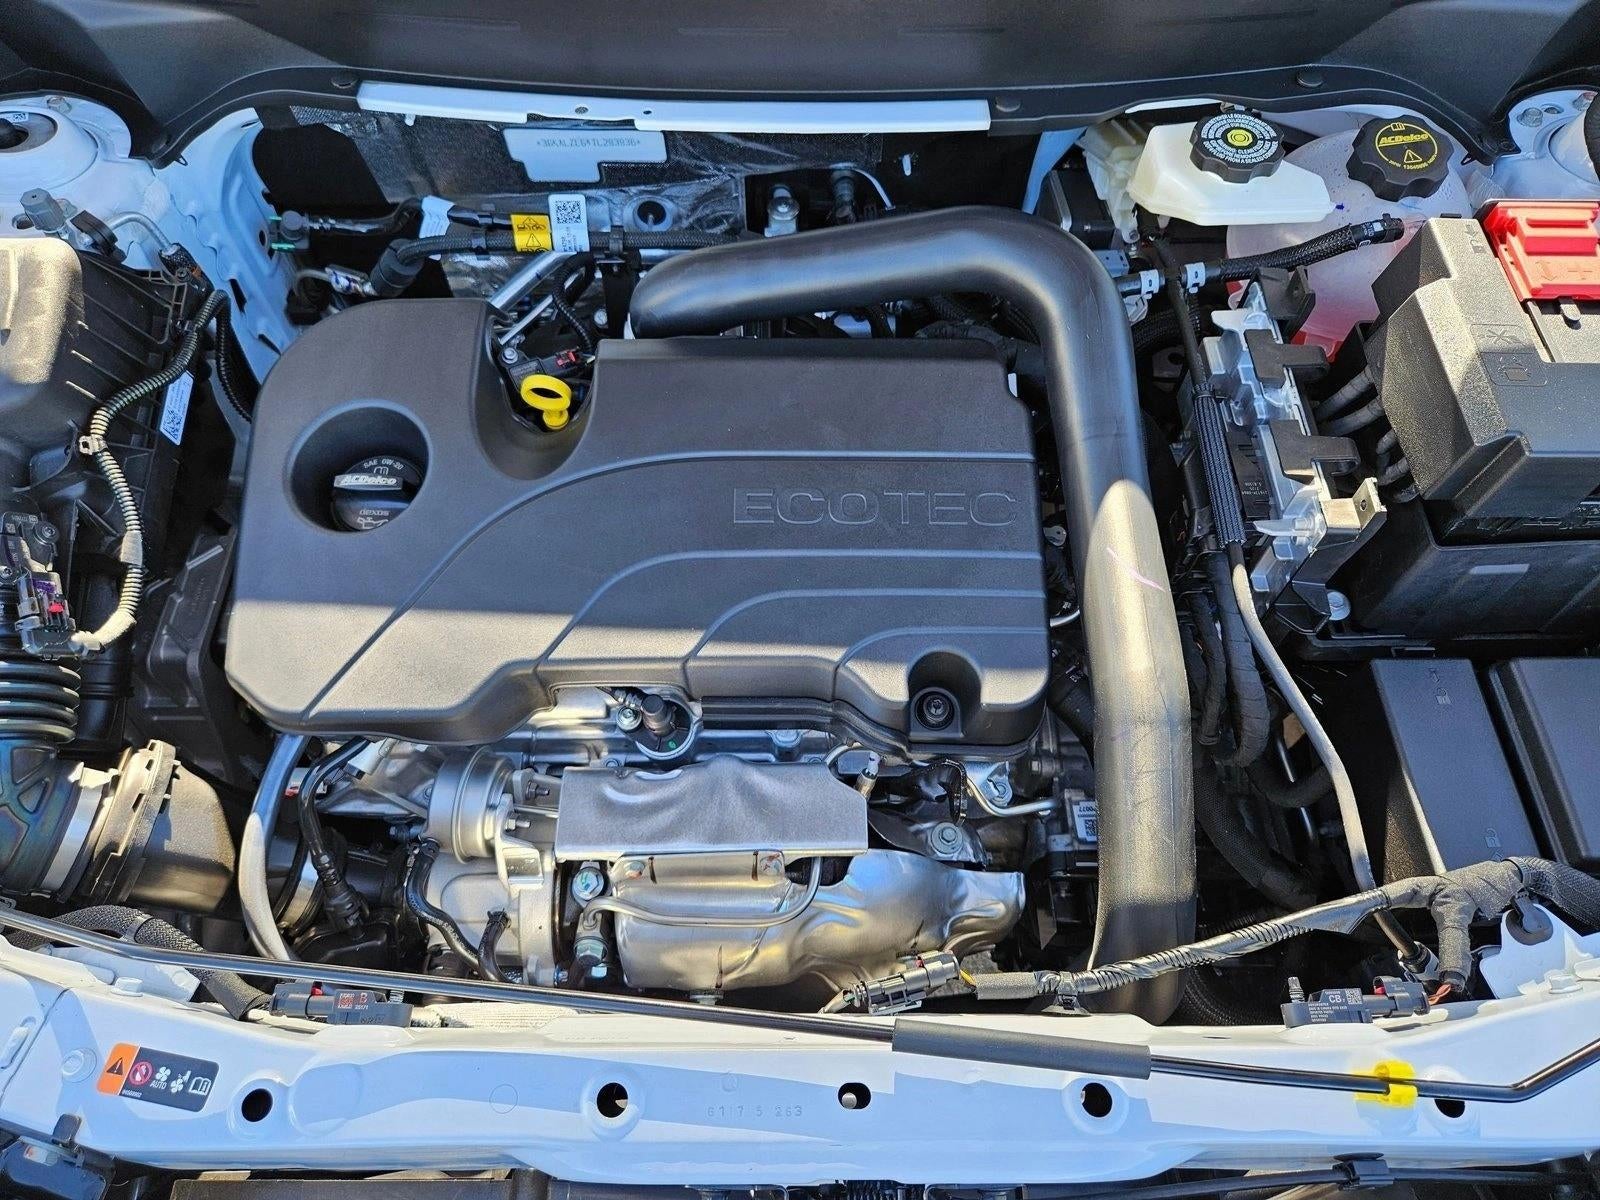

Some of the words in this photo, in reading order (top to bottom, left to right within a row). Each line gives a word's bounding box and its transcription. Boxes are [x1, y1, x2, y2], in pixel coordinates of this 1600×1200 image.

[1379, 133, 1429, 144] ACDelco
[363, 459, 378, 468] SAE
[341, 475, 397, 486] ACDelco
[733, 488, 1017, 526] ECOTEC
[1328, 995, 1341, 1003] CB
[150, 1080, 168, 1090] AUTO
